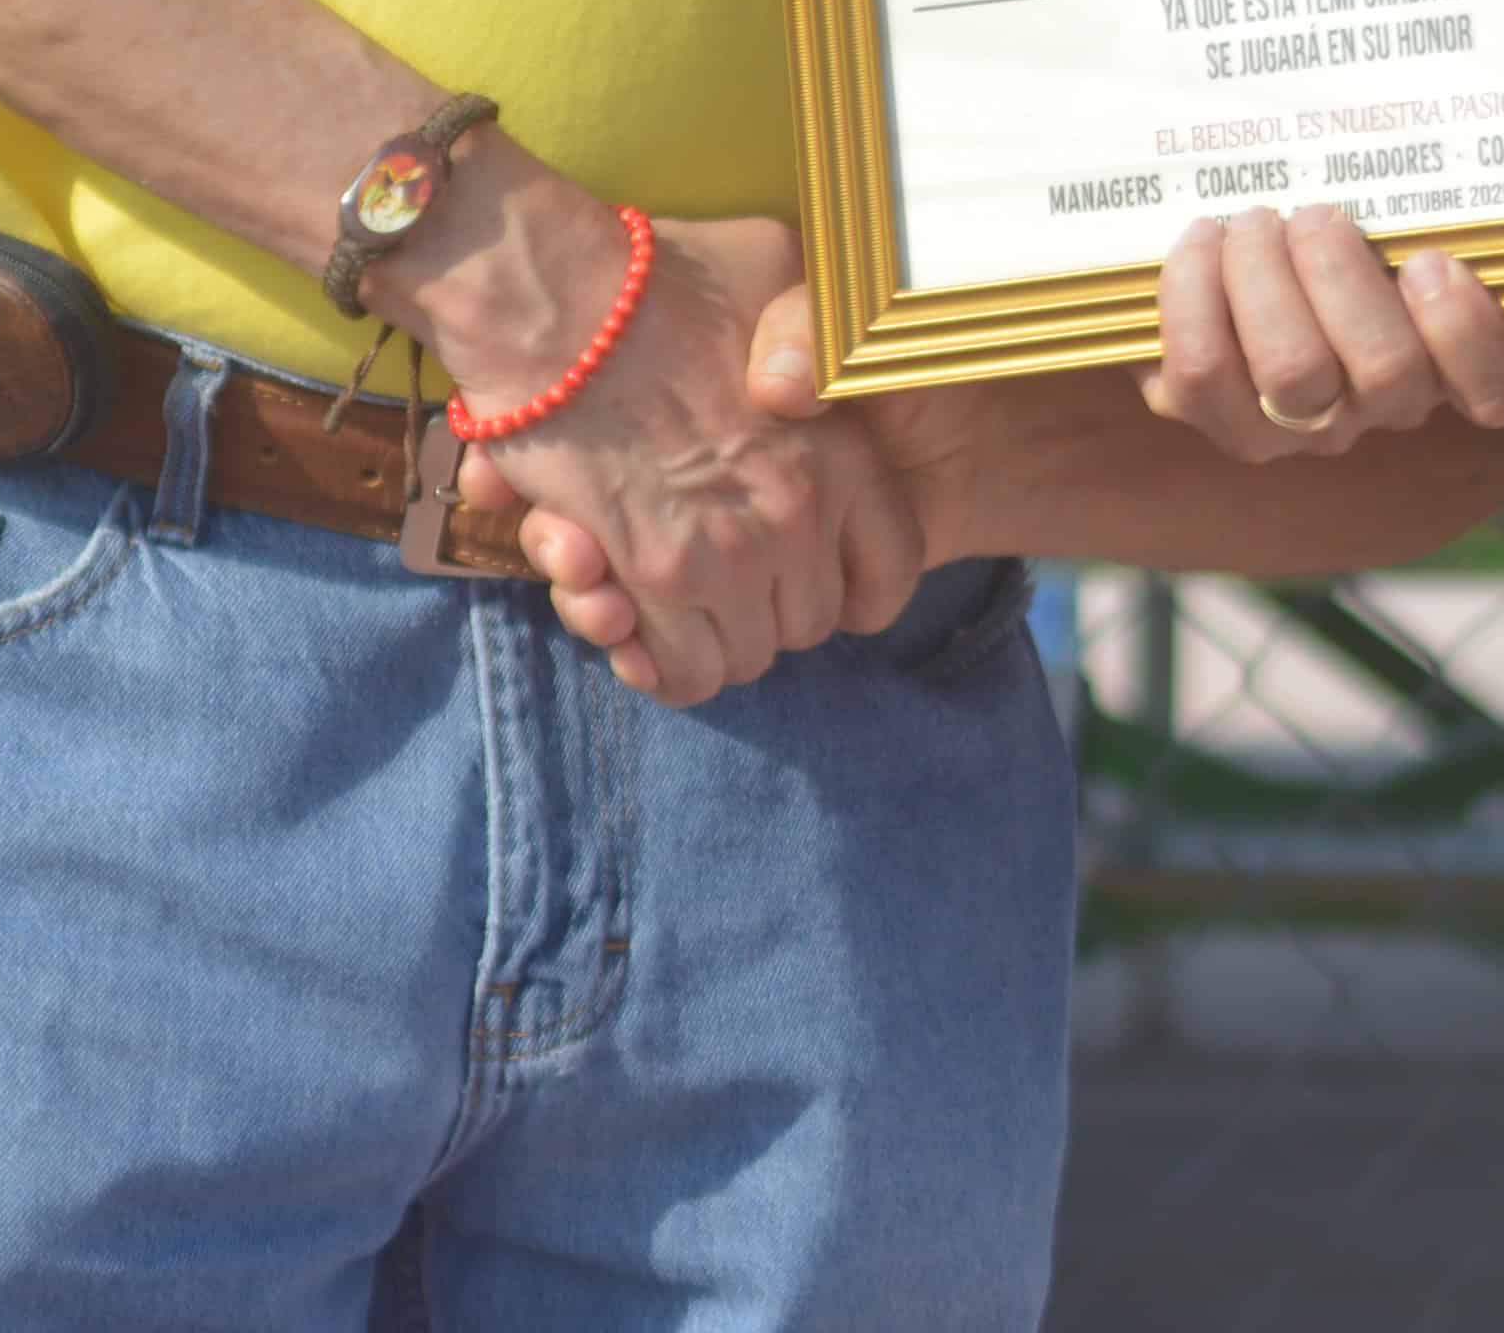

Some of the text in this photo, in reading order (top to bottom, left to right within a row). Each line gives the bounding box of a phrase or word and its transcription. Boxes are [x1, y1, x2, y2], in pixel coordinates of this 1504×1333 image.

[1205, 14, 1474, 80] SE JUGARÁ EN SU HONOR
[1155, 129, 1185, 156] EL
[1192, 115, 1290, 152] BEISBOL
[1297, 110, 1325, 138] ES
[1328, 100, 1444, 135] NUESTRA
[1047, 173, 1163, 216] MANAGERS
[1195, 158, 1289, 200] COACHES
[1322, 142, 1444, 186] JUGADORES
[1386, 188, 1464, 216] OCTUBRE
